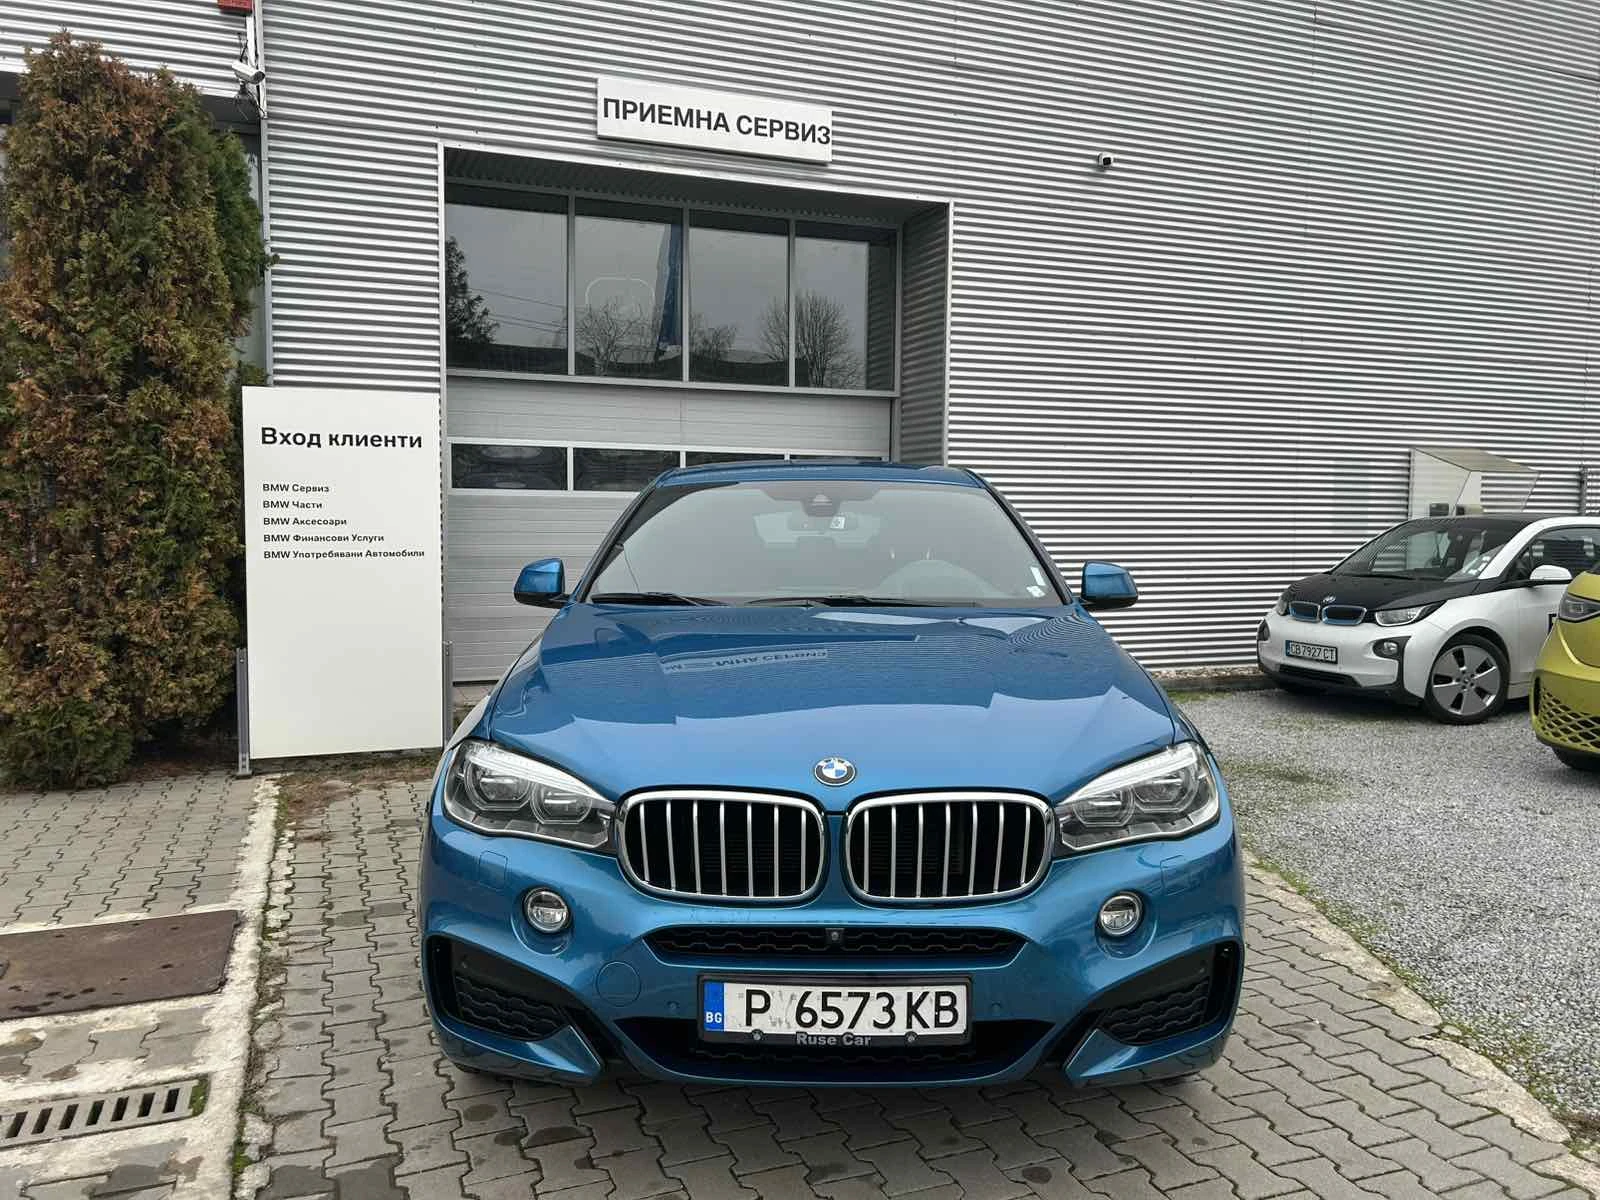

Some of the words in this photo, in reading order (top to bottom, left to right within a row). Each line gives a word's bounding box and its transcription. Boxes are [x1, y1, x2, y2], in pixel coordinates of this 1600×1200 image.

[603, 97, 730, 133] ПРИЕМНА
[736, 114, 831, 145] СЕРВИЗ
[261, 426, 322, 448] Вход
[328, 433, 423, 448] клиенти
[262, 483, 290, 492] BMW
[291, 484, 330, 494] Сервиз
[262, 500, 290, 509] BMW
[291, 500, 323, 509] Части
[263, 517, 290, 526] BMW
[292, 517, 347, 527] Аксесоари
[263, 534, 290, 542] BMW
[292, 534, 349, 542] Финансови
[351, 534, 385, 544] Услуги
[263, 551, 290, 559] BMW
[292, 551, 363, 560] Употребявани
[365, 549, 425, 558] Автомобили
[745, 989, 771, 1027] P
[795, 990, 896, 1030] 6573
[906, 990, 959, 1029] KB
[705, 1012, 722, 1024] BG
[796, 1032, 837, 1046] Ruse
[842, 1032, 871, 1046] Car
